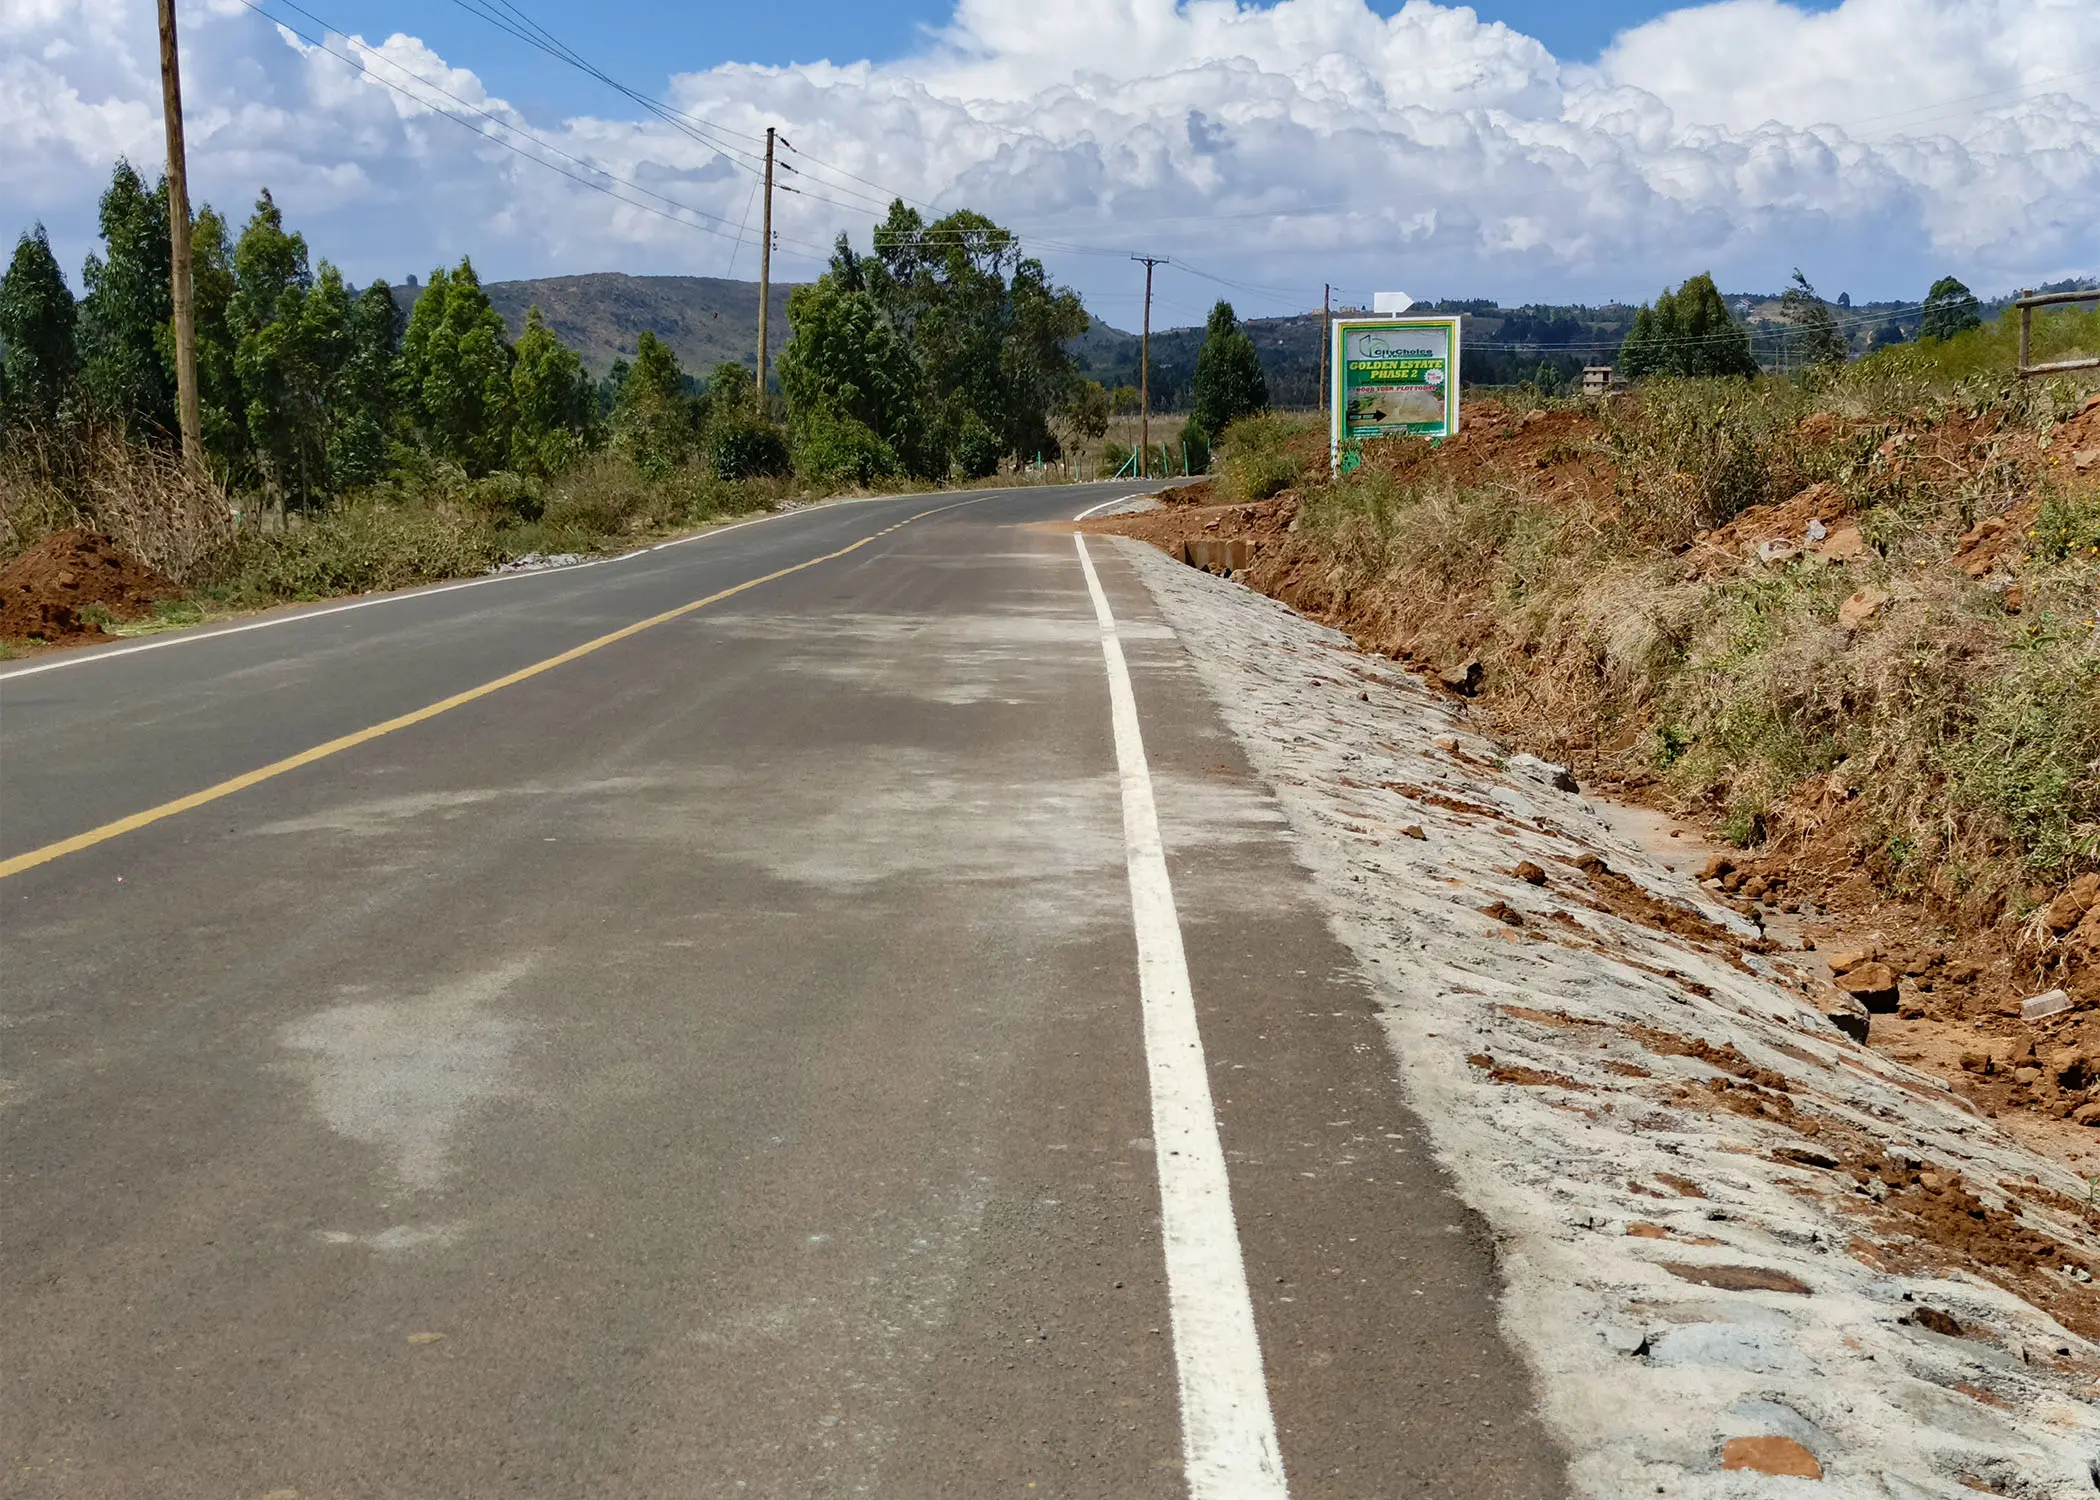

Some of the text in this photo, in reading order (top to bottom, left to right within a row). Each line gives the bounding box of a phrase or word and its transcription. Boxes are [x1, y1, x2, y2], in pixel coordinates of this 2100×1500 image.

[1349, 360, 1443, 370] GOLDEN ESTATE
[1370, 370, 1409, 379] PHASE
[1411, 370, 1418, 378] 2
